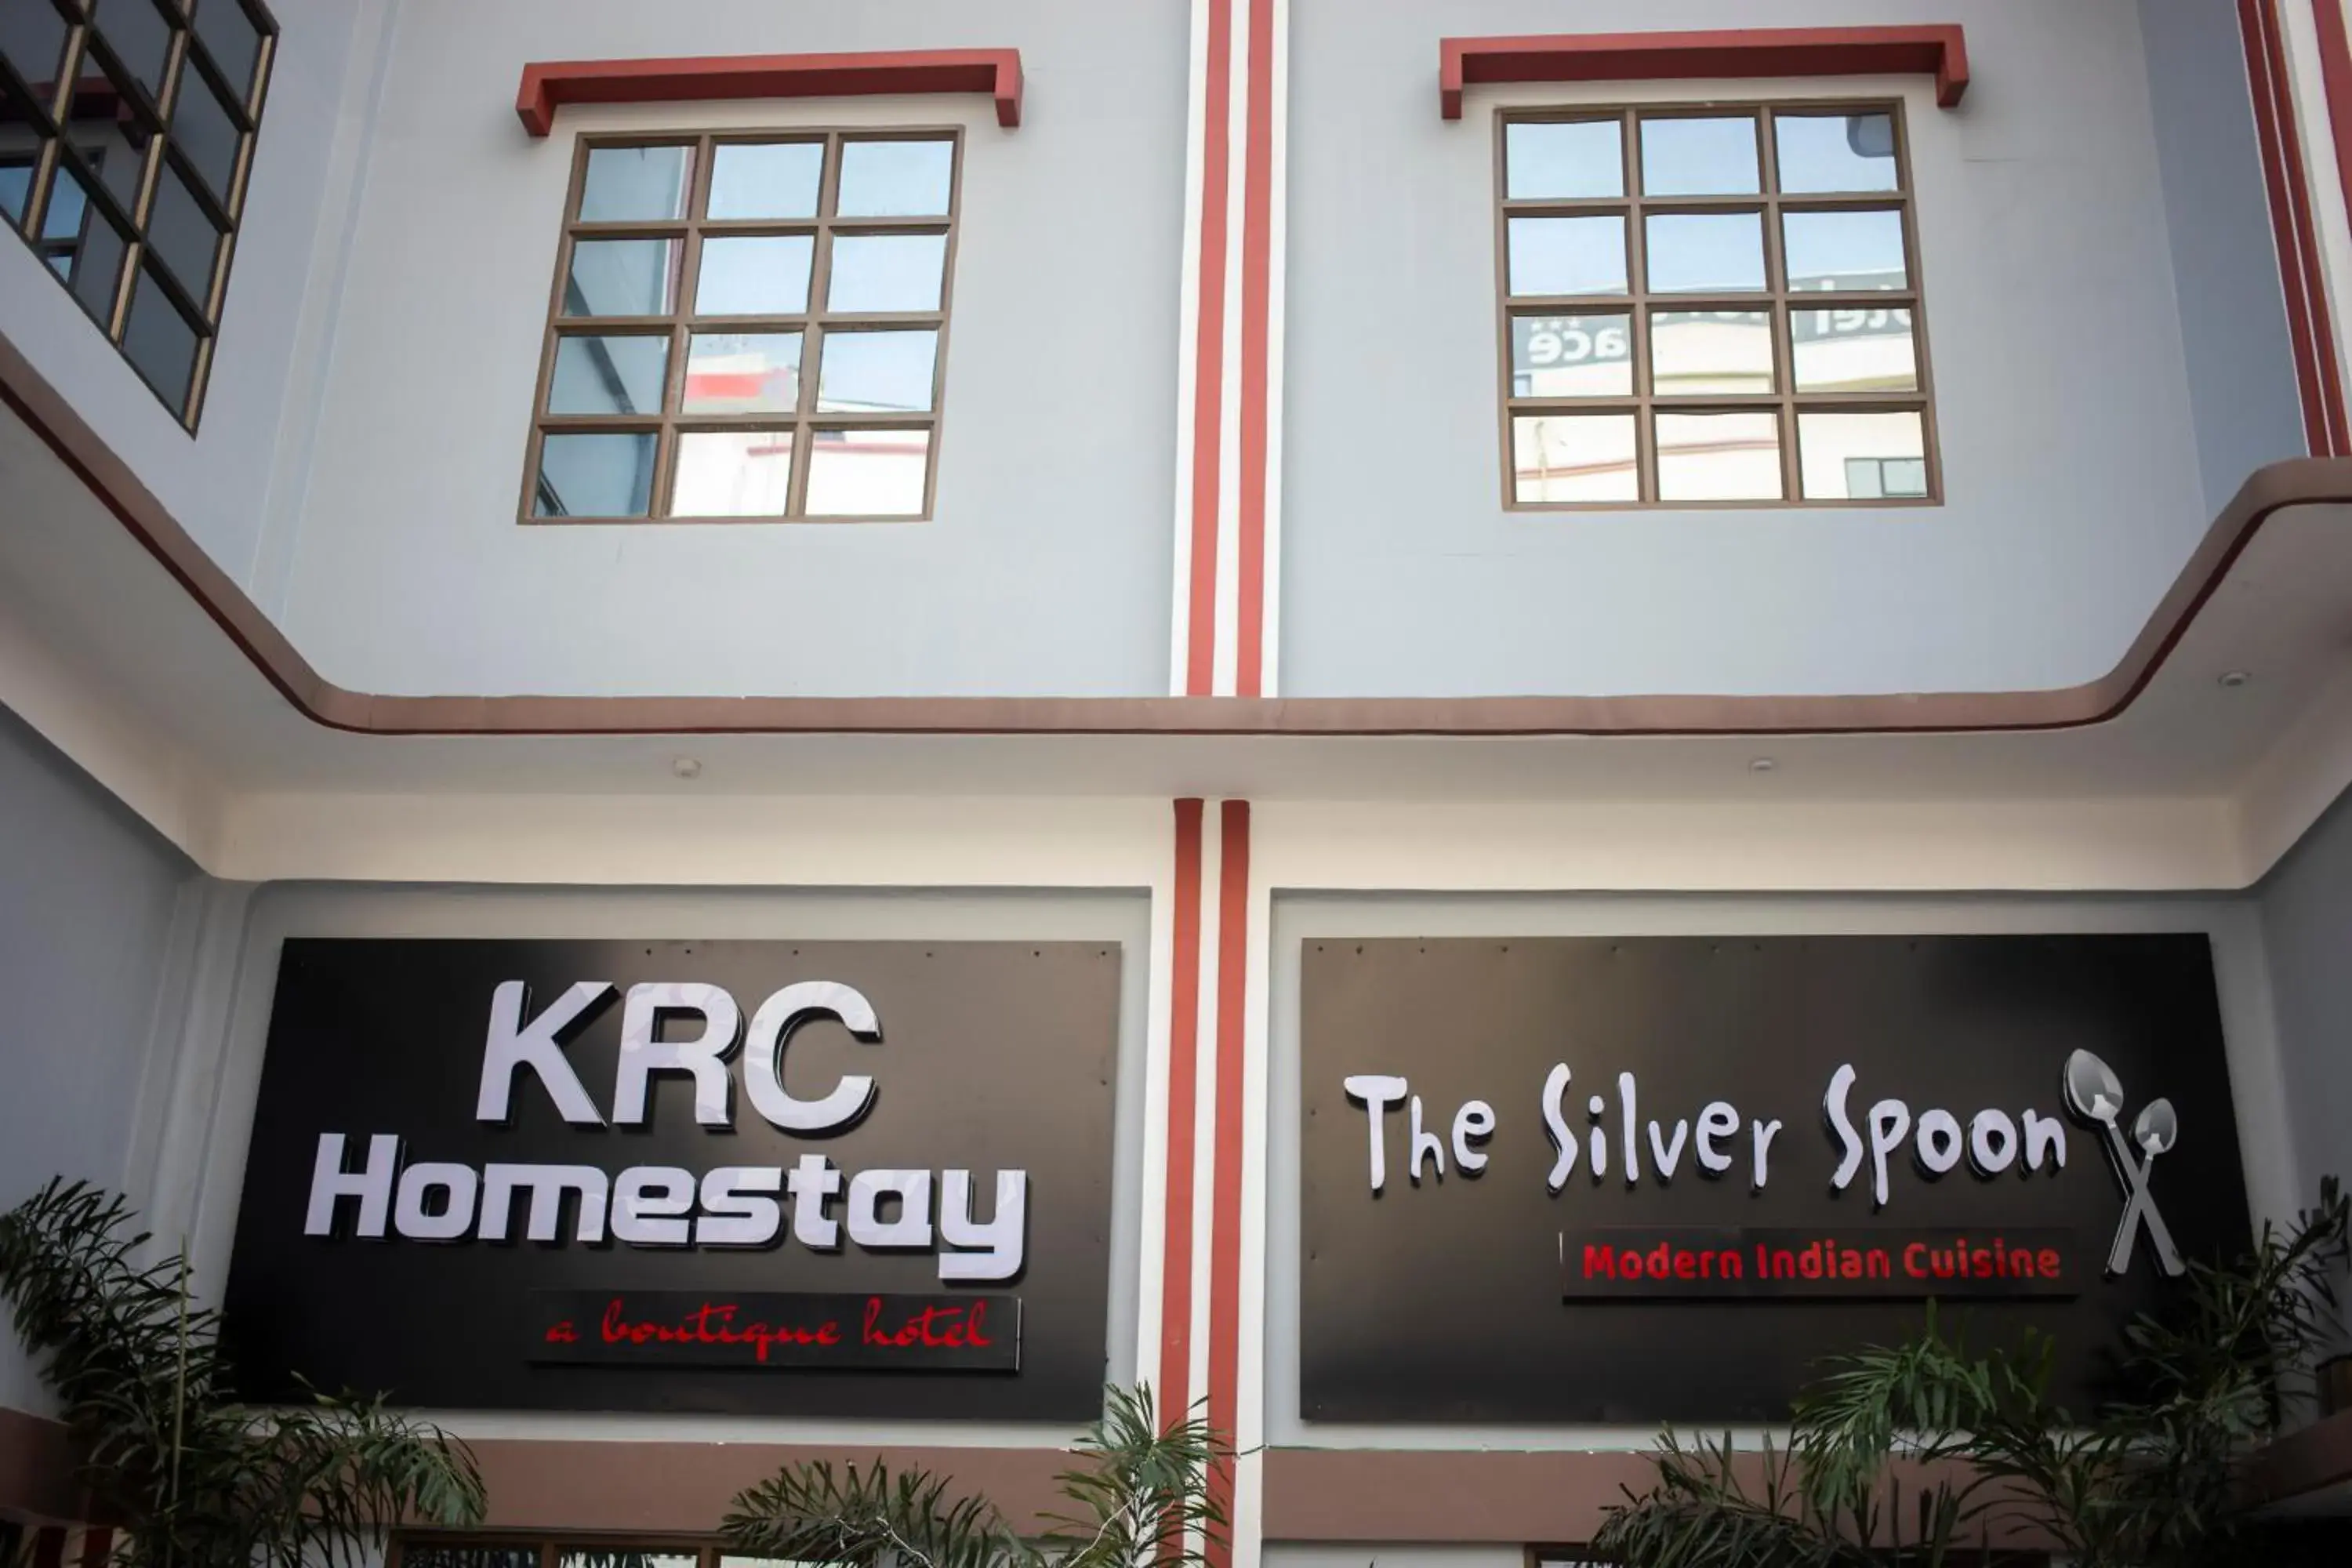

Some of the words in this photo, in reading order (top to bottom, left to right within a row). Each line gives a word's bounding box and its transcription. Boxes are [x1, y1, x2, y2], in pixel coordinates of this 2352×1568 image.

[477, 980, 880, 1130] KRC
[1343, 1074, 1496, 1191] The
[1541, 1062, 1783, 1192] Silver
[1824, 1063, 2067, 1205] Spoon
[304, 1132, 1028, 1279] Homestay
[1582, 1241, 1744, 1280] Modern
[1756, 1239, 1892, 1280] Indian
[1903, 1237, 2062, 1280] Cuisine
[544, 1319, 579, 1345] a
[601, 1298, 842, 1363] boutique
[862, 1296, 992, 1348] hotel
